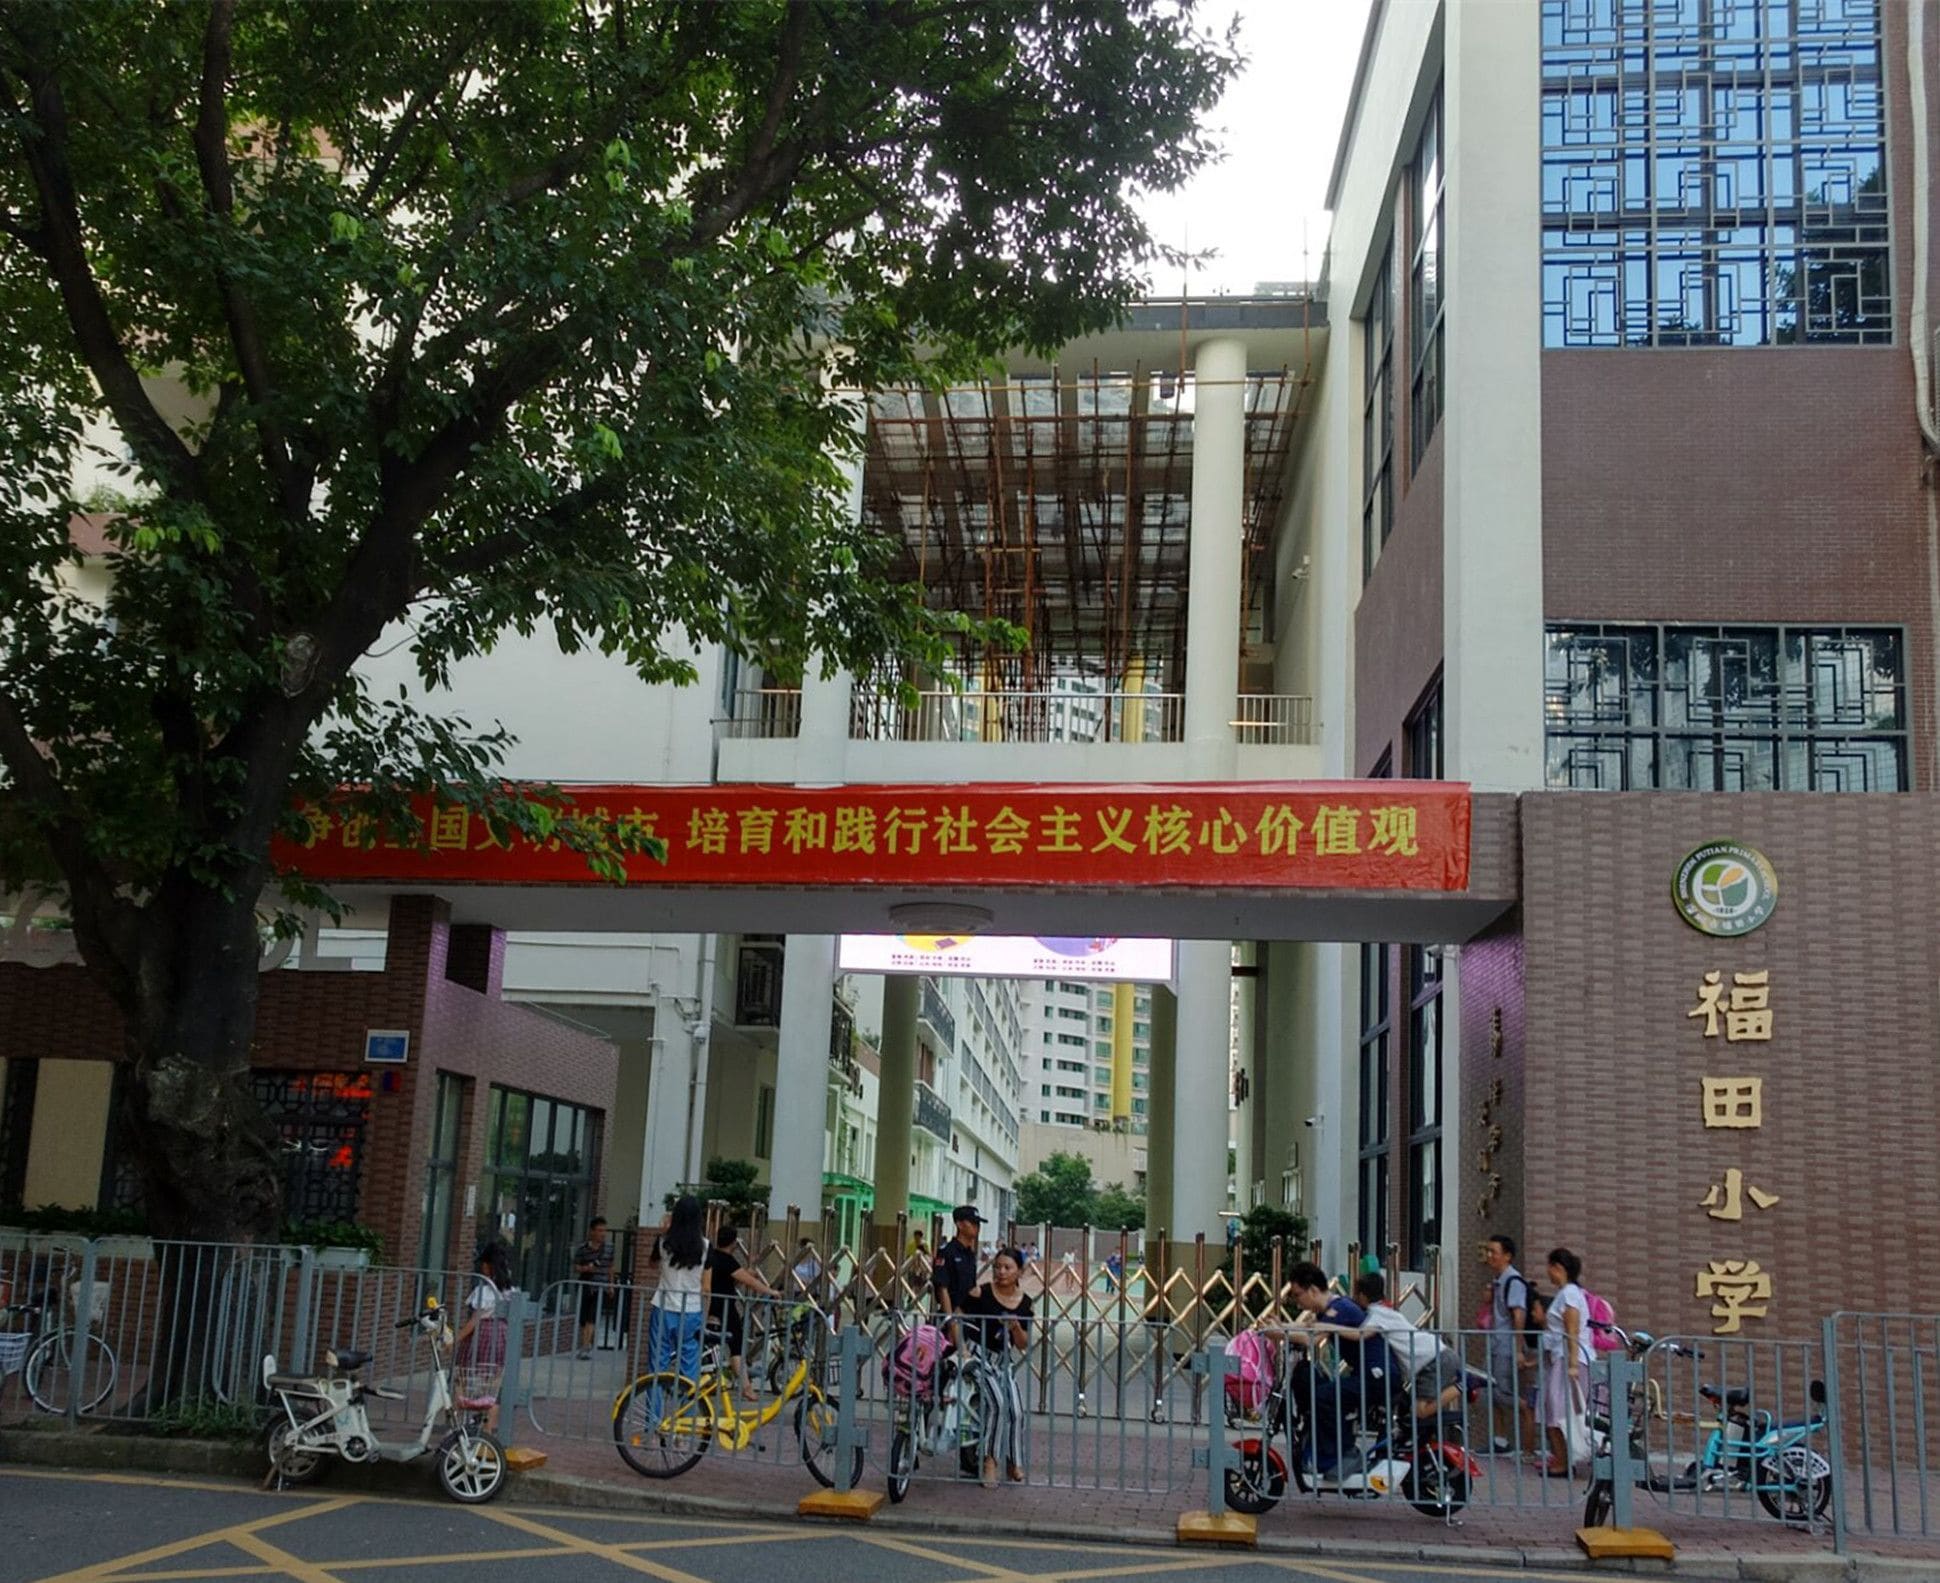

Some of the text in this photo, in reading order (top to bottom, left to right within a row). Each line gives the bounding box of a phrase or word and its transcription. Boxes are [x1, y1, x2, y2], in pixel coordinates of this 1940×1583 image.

[686, 804, 1419, 856] 培育和践行社会主义核心价值观
[1687, 969, 1780, 1334] 福田小学
